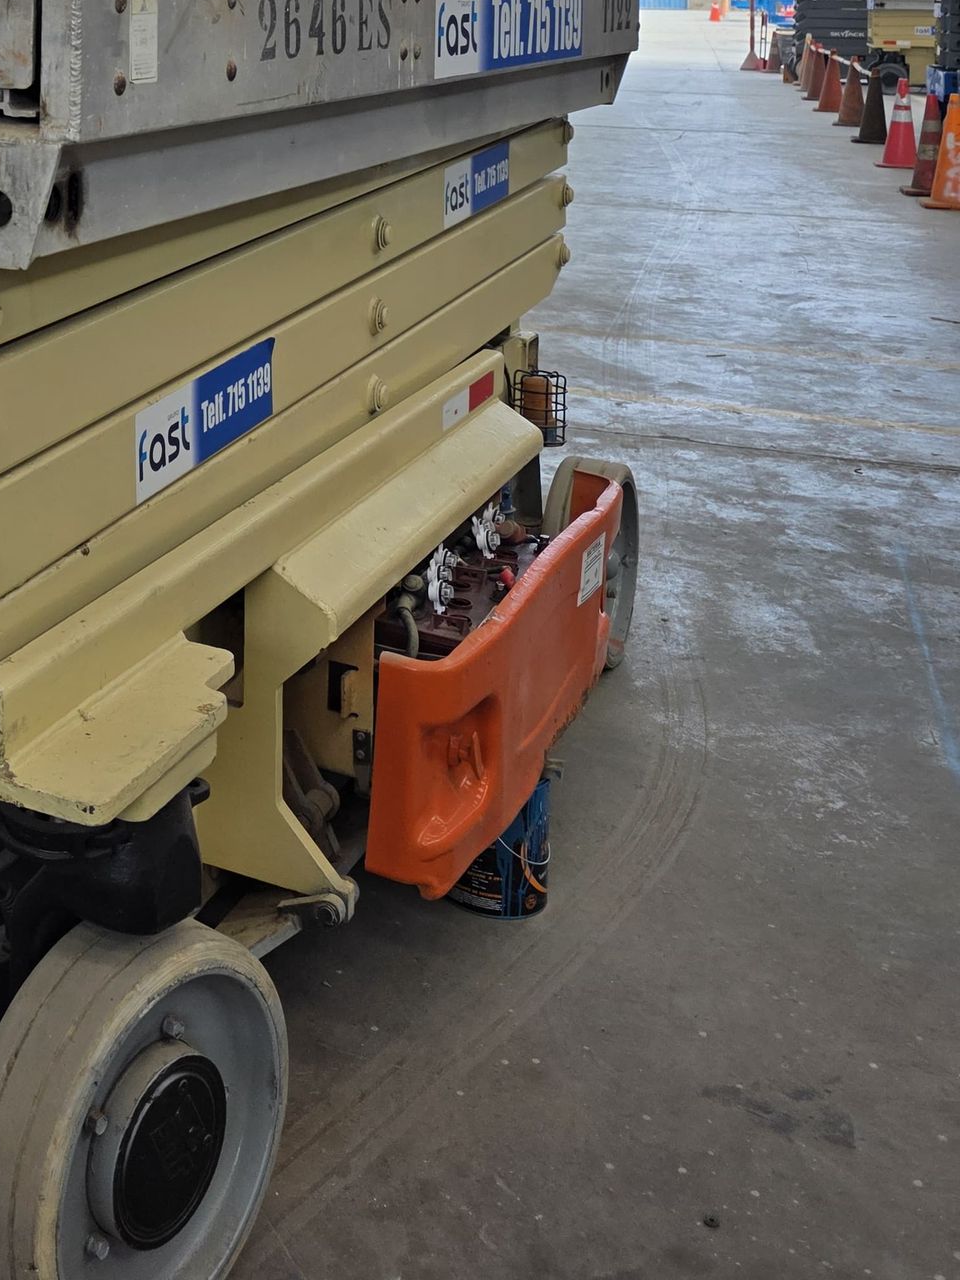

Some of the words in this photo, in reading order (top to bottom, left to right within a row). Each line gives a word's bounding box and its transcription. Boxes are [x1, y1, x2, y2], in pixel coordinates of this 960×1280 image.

[437, 0, 478, 58] fast
[444, 172, 470, 216] fast
[201, 390, 227, 433] Telf.
[227, 377, 246, 417] 715
[247, 362, 271, 404] 1139
[138, 405, 191, 483] fast
